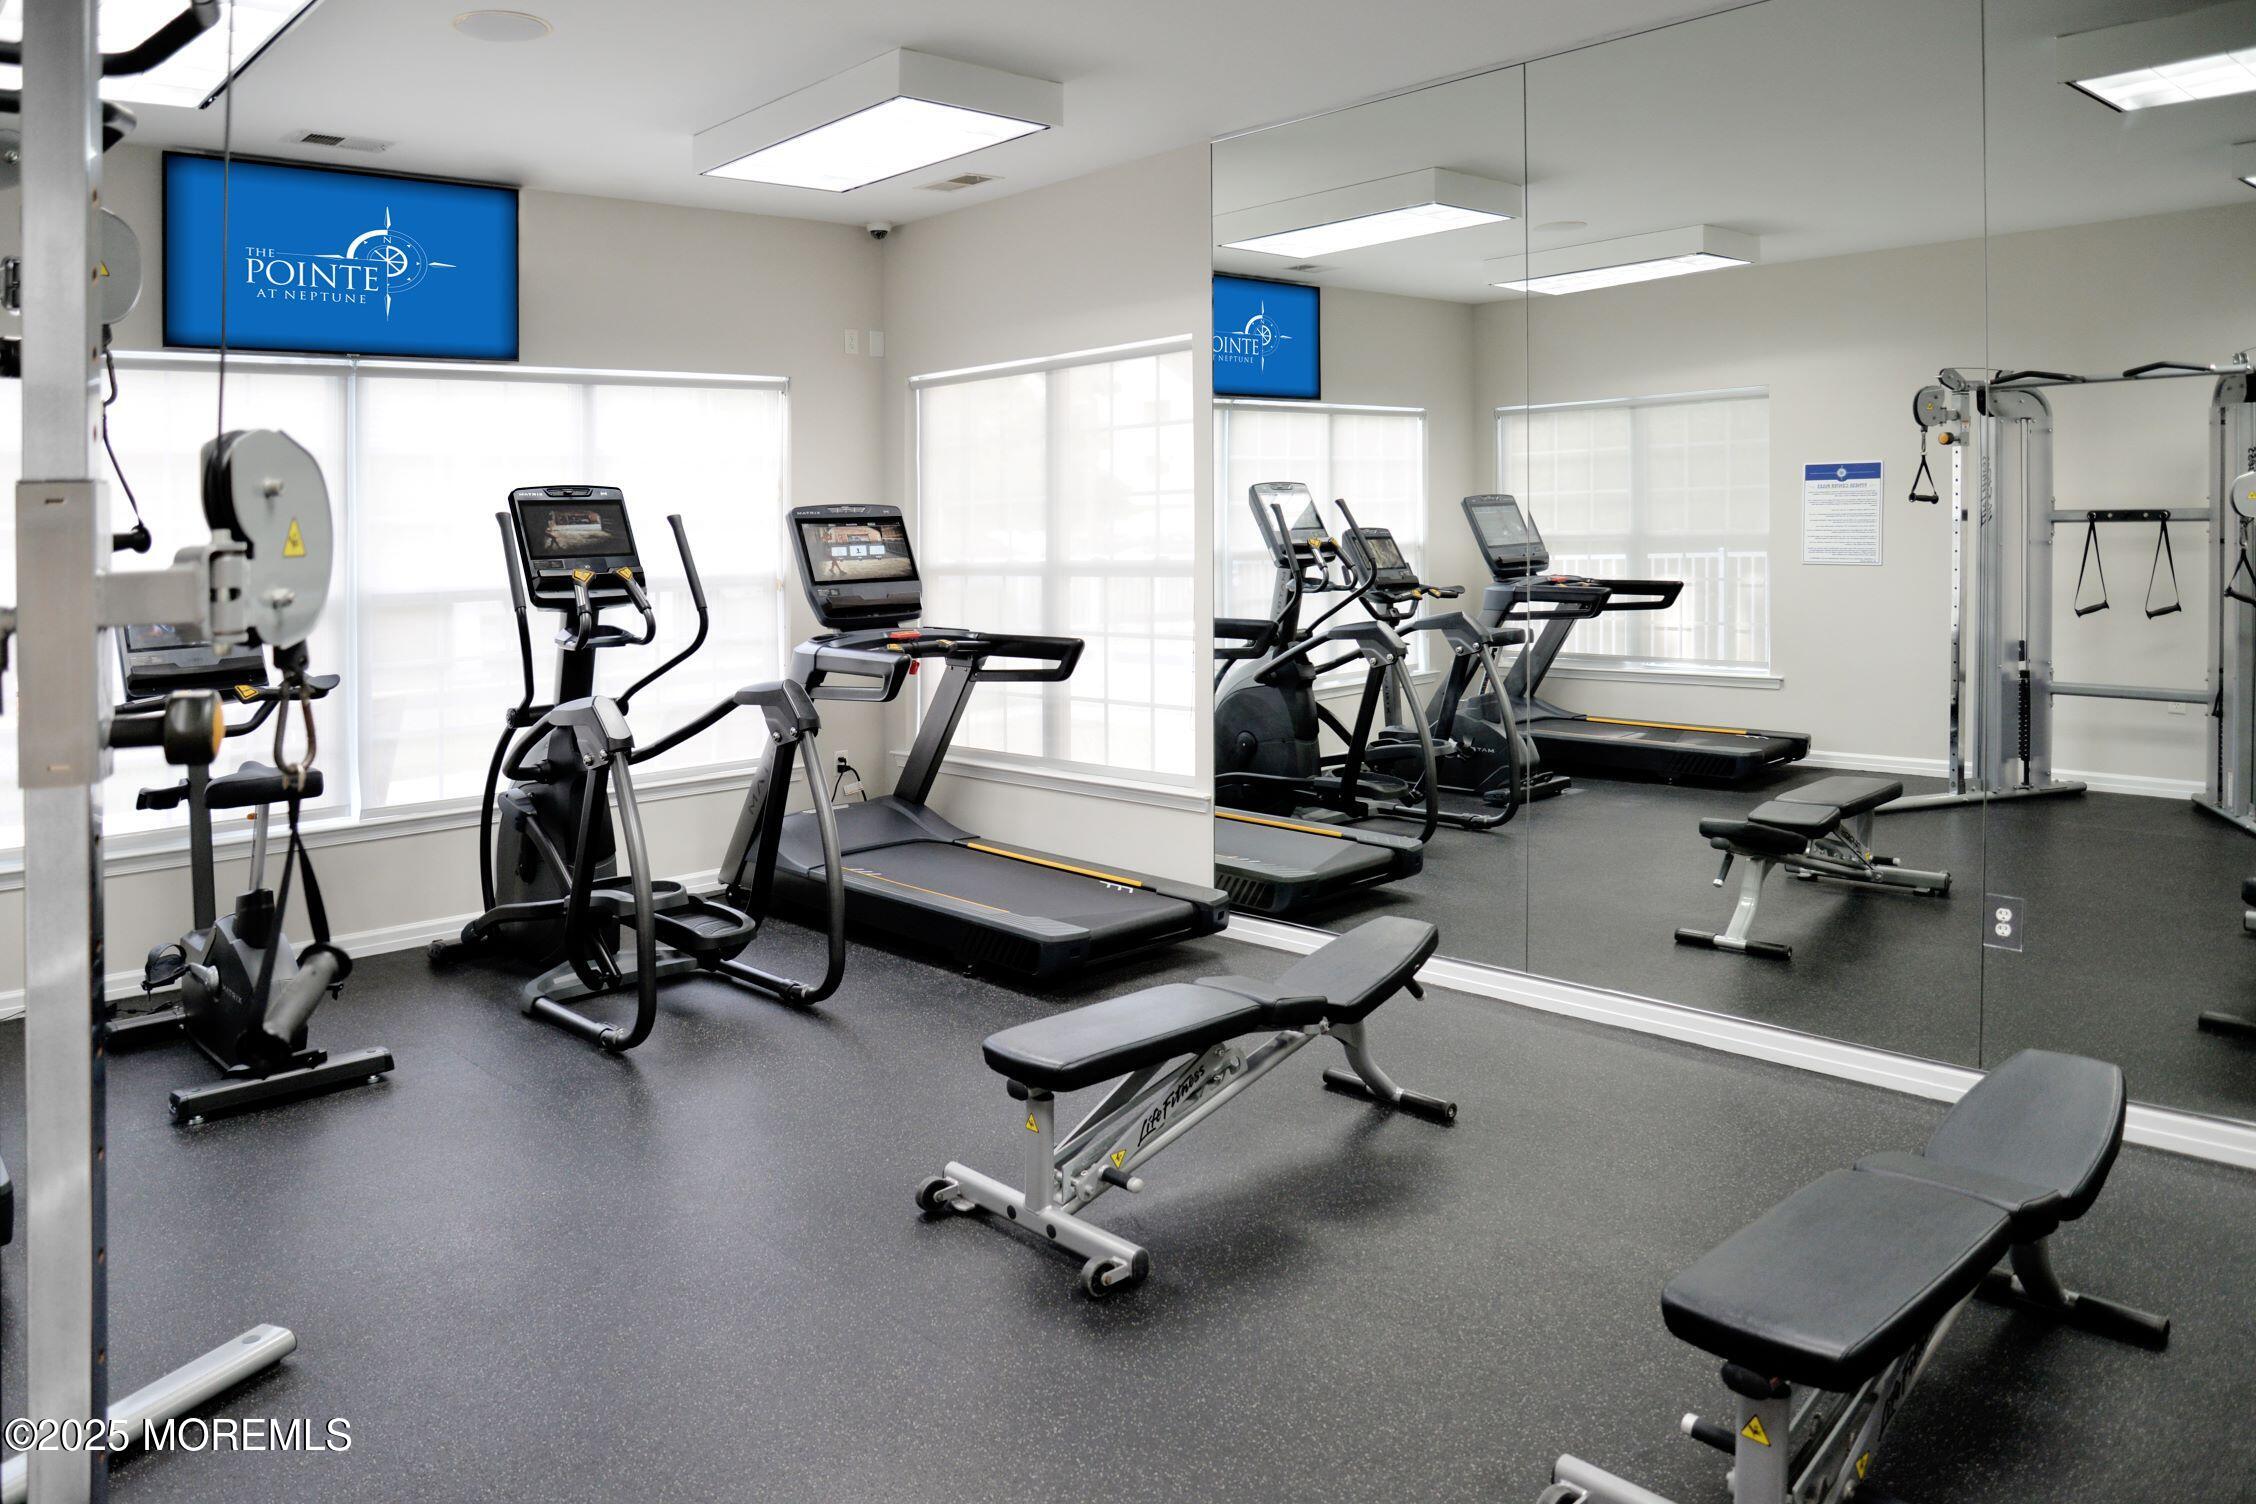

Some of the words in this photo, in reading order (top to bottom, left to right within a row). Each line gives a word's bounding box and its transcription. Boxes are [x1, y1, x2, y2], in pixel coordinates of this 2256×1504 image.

[245, 246, 276, 258] THE
[245, 258, 380, 292] POINTE
[256, 288, 278, 299] AT
[285, 290, 367, 304] NEPTUNE
[1137, 1107, 1163, 1148] Life
[1162, 1064, 1206, 1120] Fitness
